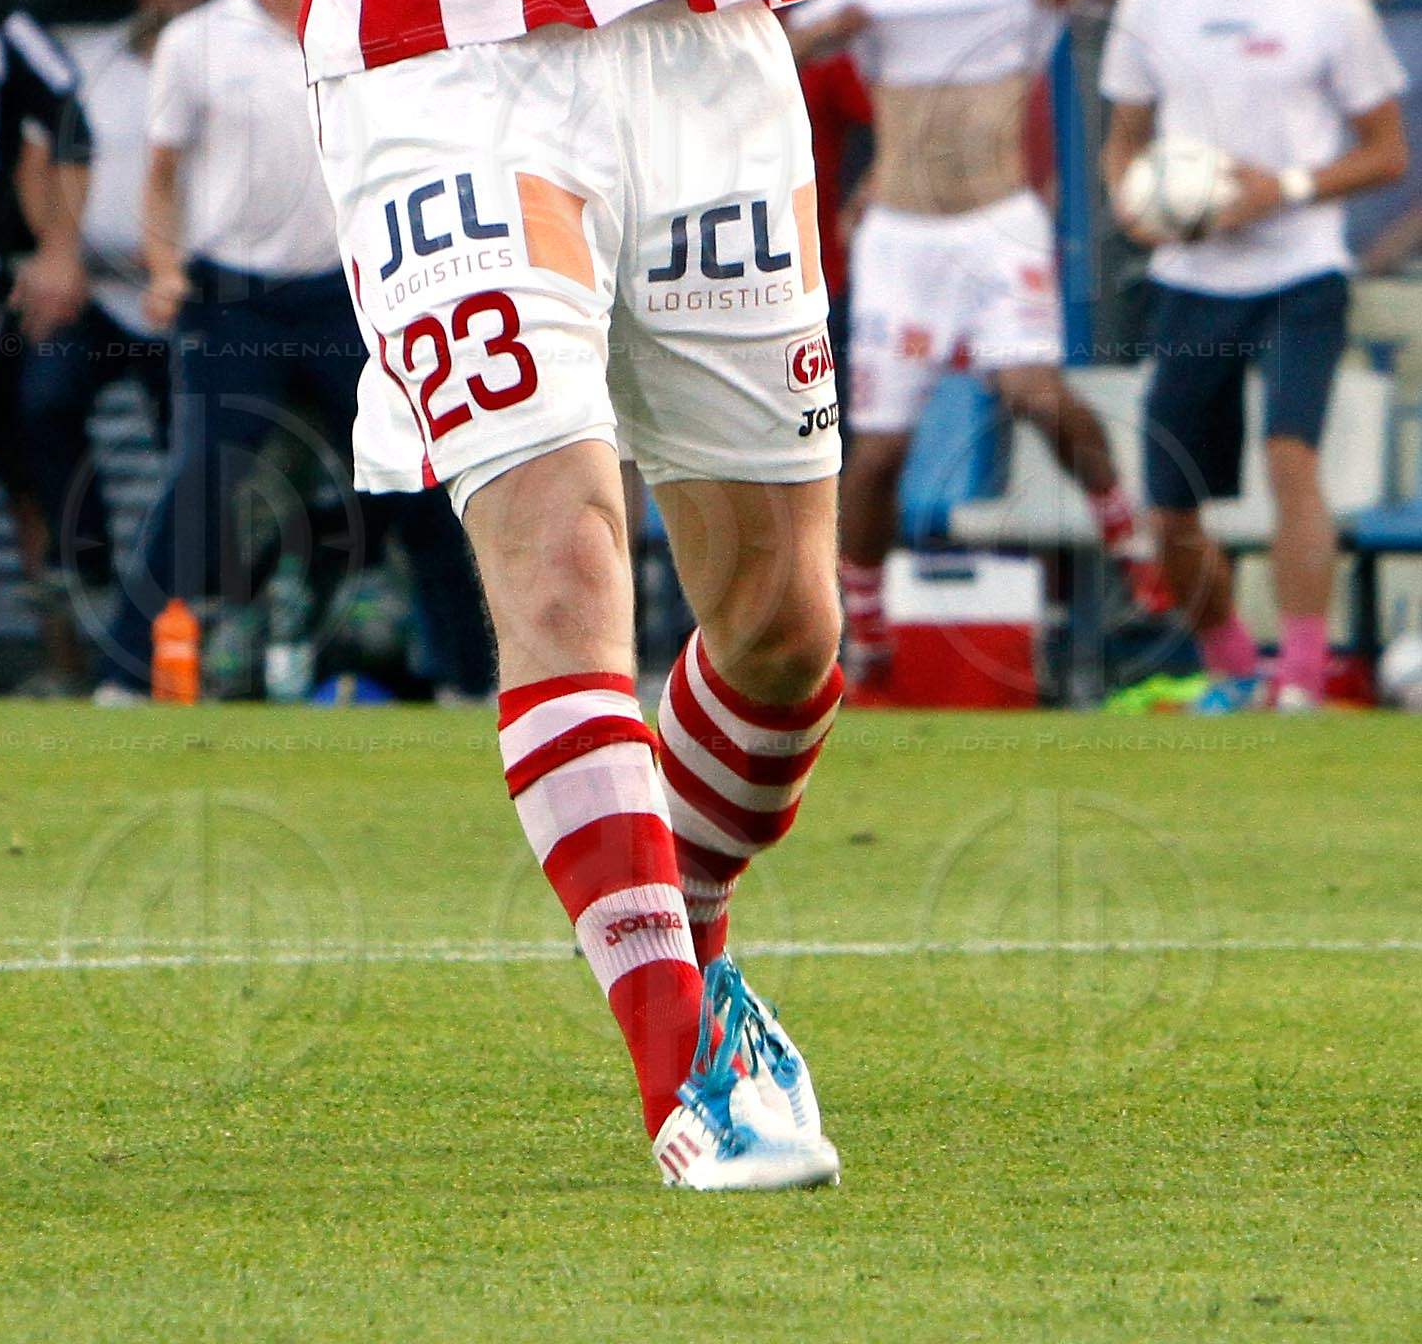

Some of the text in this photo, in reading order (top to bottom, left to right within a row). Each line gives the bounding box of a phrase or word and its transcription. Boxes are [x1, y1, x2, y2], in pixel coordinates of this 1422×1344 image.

[380, 173, 509, 280] JCL
[647, 200, 792, 283] JCL
[385, 248, 513, 312] LOGISTICS
[647, 280, 794, 313] LOGISTICS
[402, 290, 538, 441] 23
